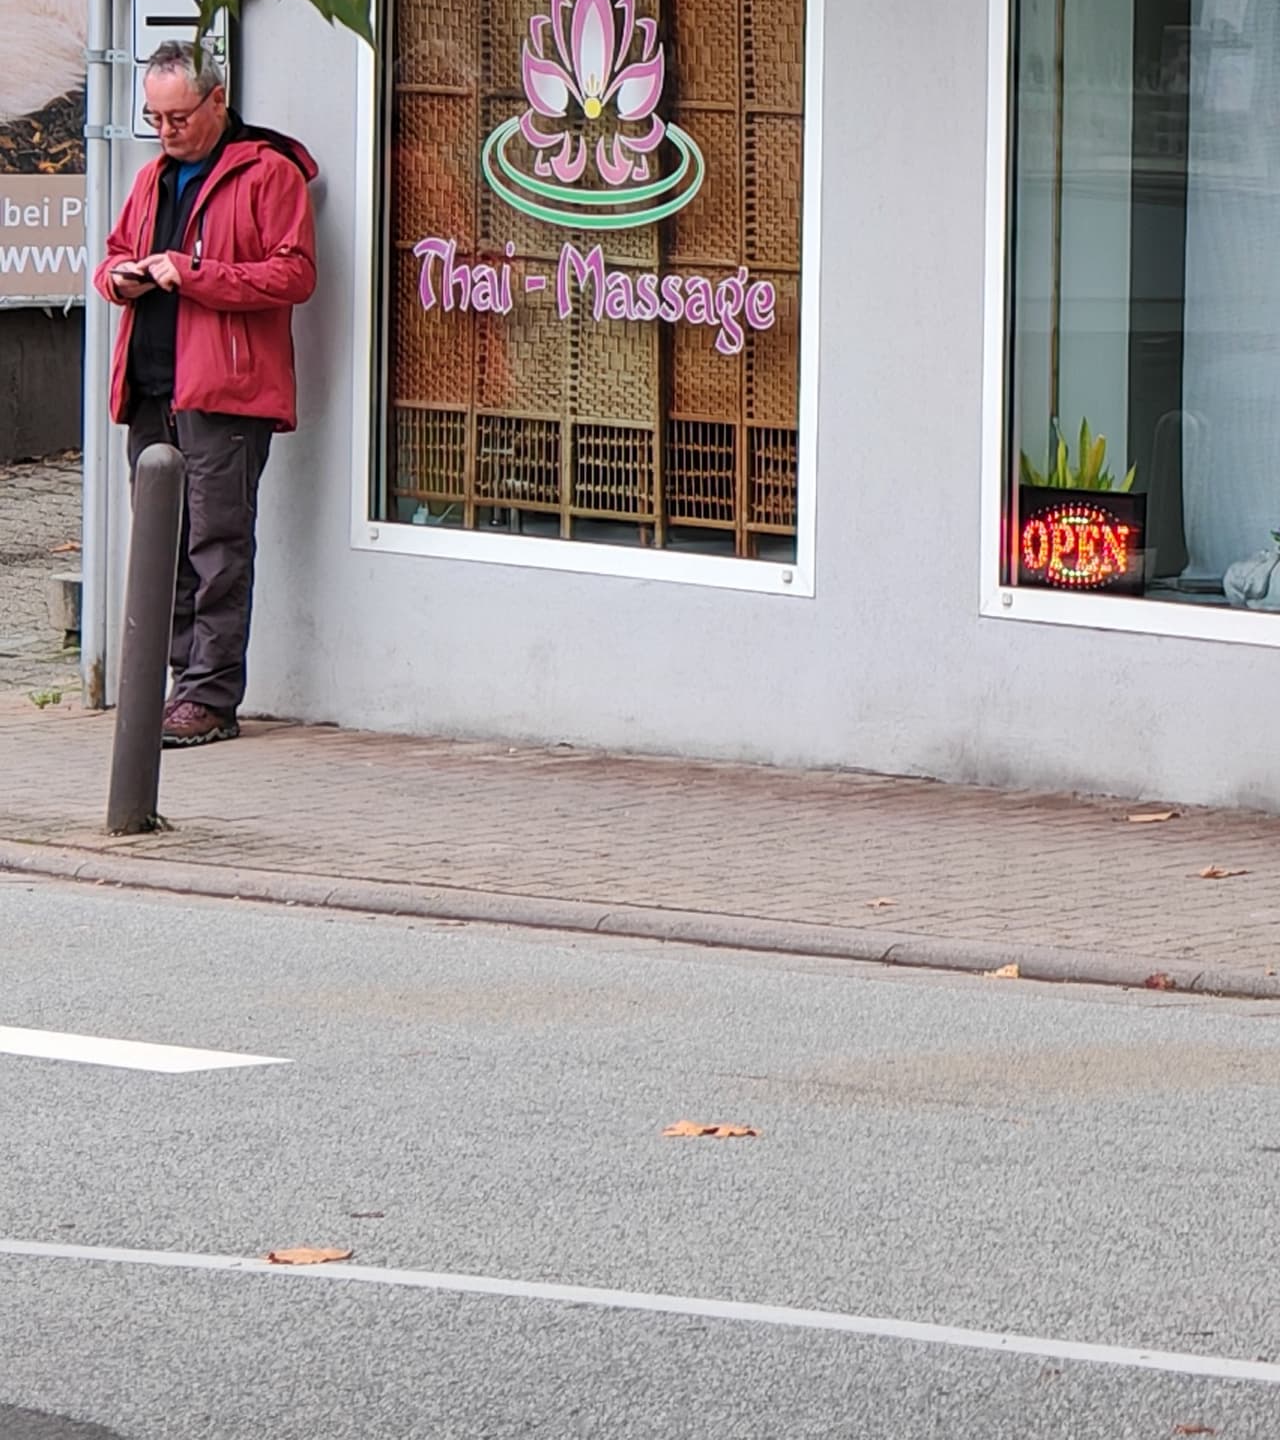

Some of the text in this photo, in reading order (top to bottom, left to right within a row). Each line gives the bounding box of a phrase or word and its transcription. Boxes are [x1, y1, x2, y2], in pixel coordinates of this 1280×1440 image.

[4, 196, 49, 227] bei
[413, 238, 516, 316] Thai
[556, 242, 777, 357] Massage
[1022, 519, 1129, 573] OPEN
